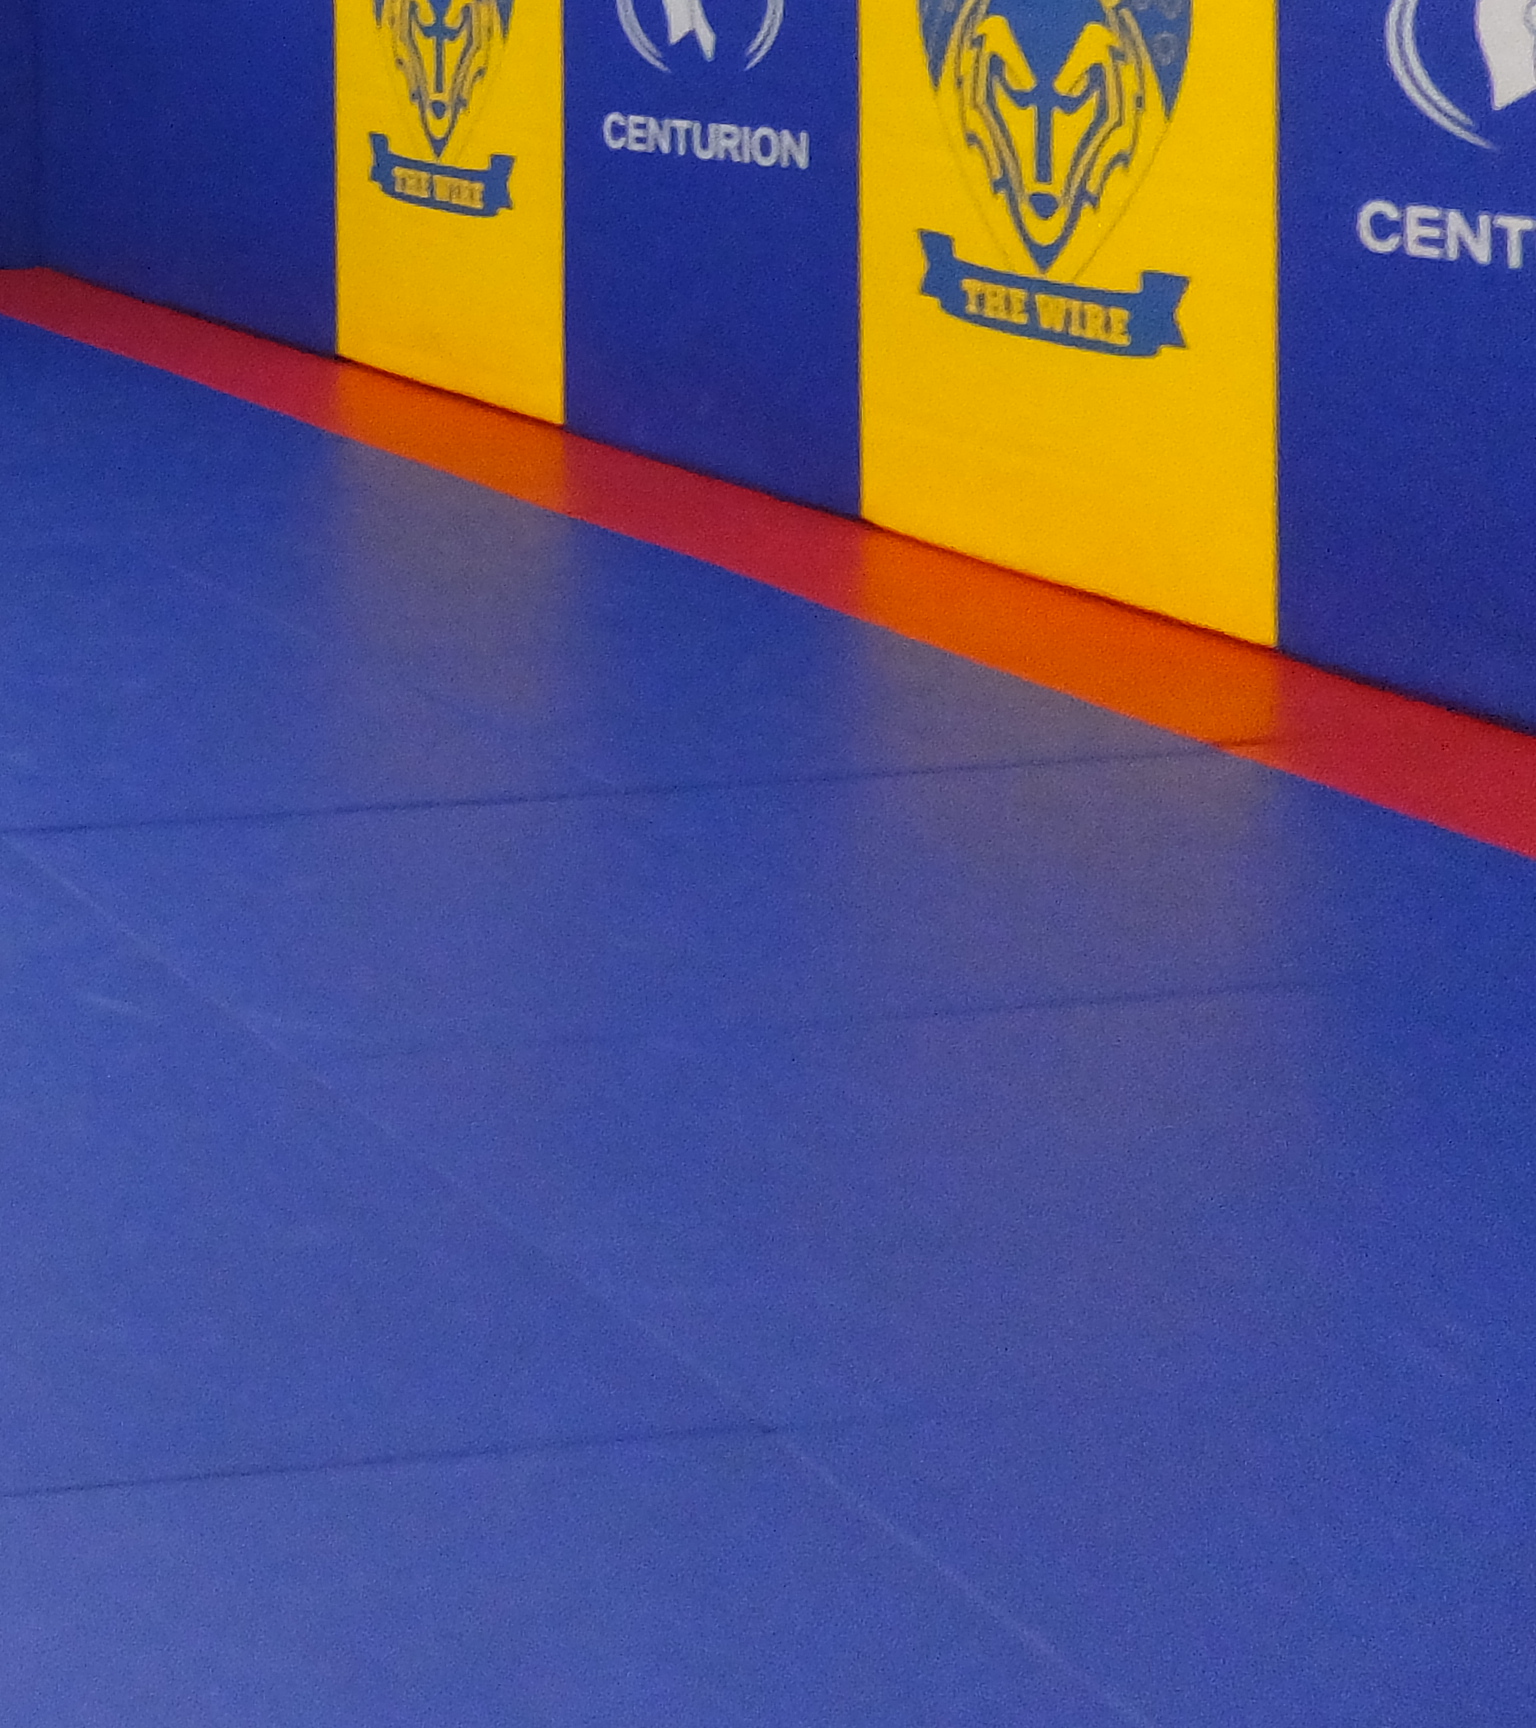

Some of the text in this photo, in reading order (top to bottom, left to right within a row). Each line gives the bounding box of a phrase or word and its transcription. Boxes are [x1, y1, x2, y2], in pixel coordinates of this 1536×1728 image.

[602, 111, 811, 171] CENTURION
[1356, 198, 1536, 270] CENT
[960, 277, 1132, 347] THE WIRE
